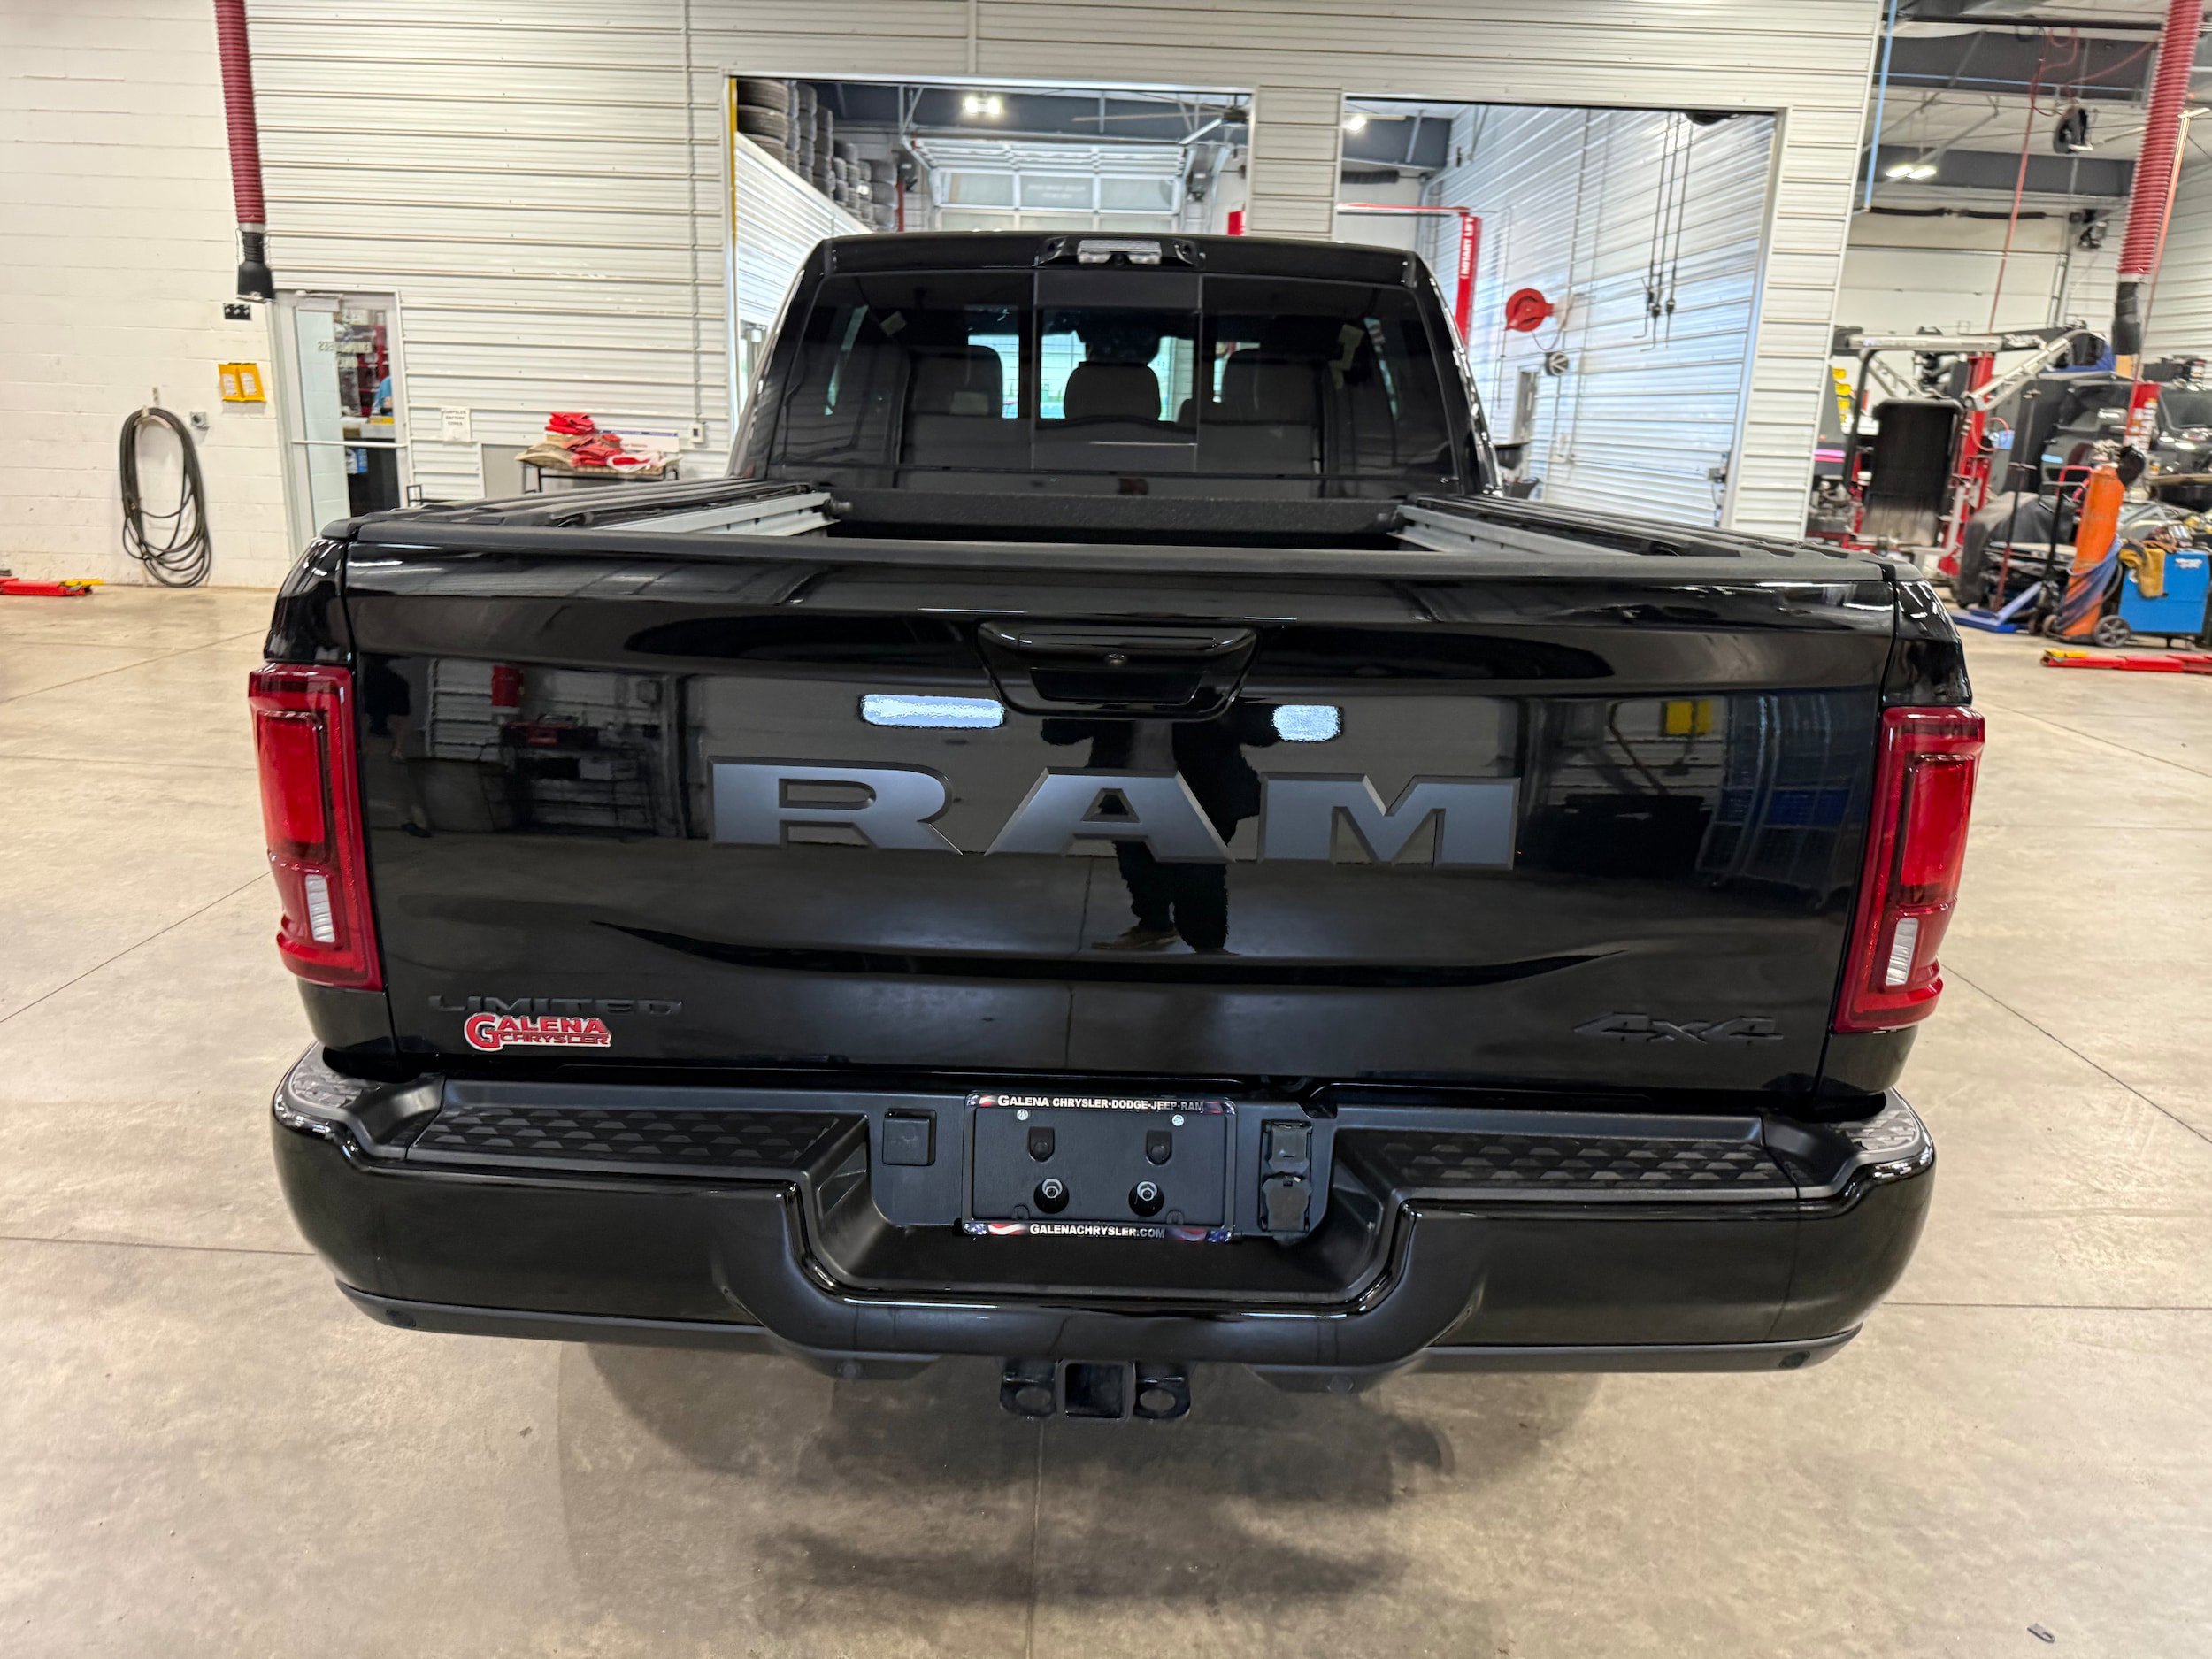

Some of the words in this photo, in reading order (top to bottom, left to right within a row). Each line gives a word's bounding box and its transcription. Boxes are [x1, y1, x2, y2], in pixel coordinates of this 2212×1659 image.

[709, 755, 1520, 870] RAM
[428, 995, 683, 1016] LIMITED
[465, 1013, 611, 1050] GALENA
[499, 1032, 611, 1045] CHRYSLER
[997, 1094, 1050, 1107] GALENA
